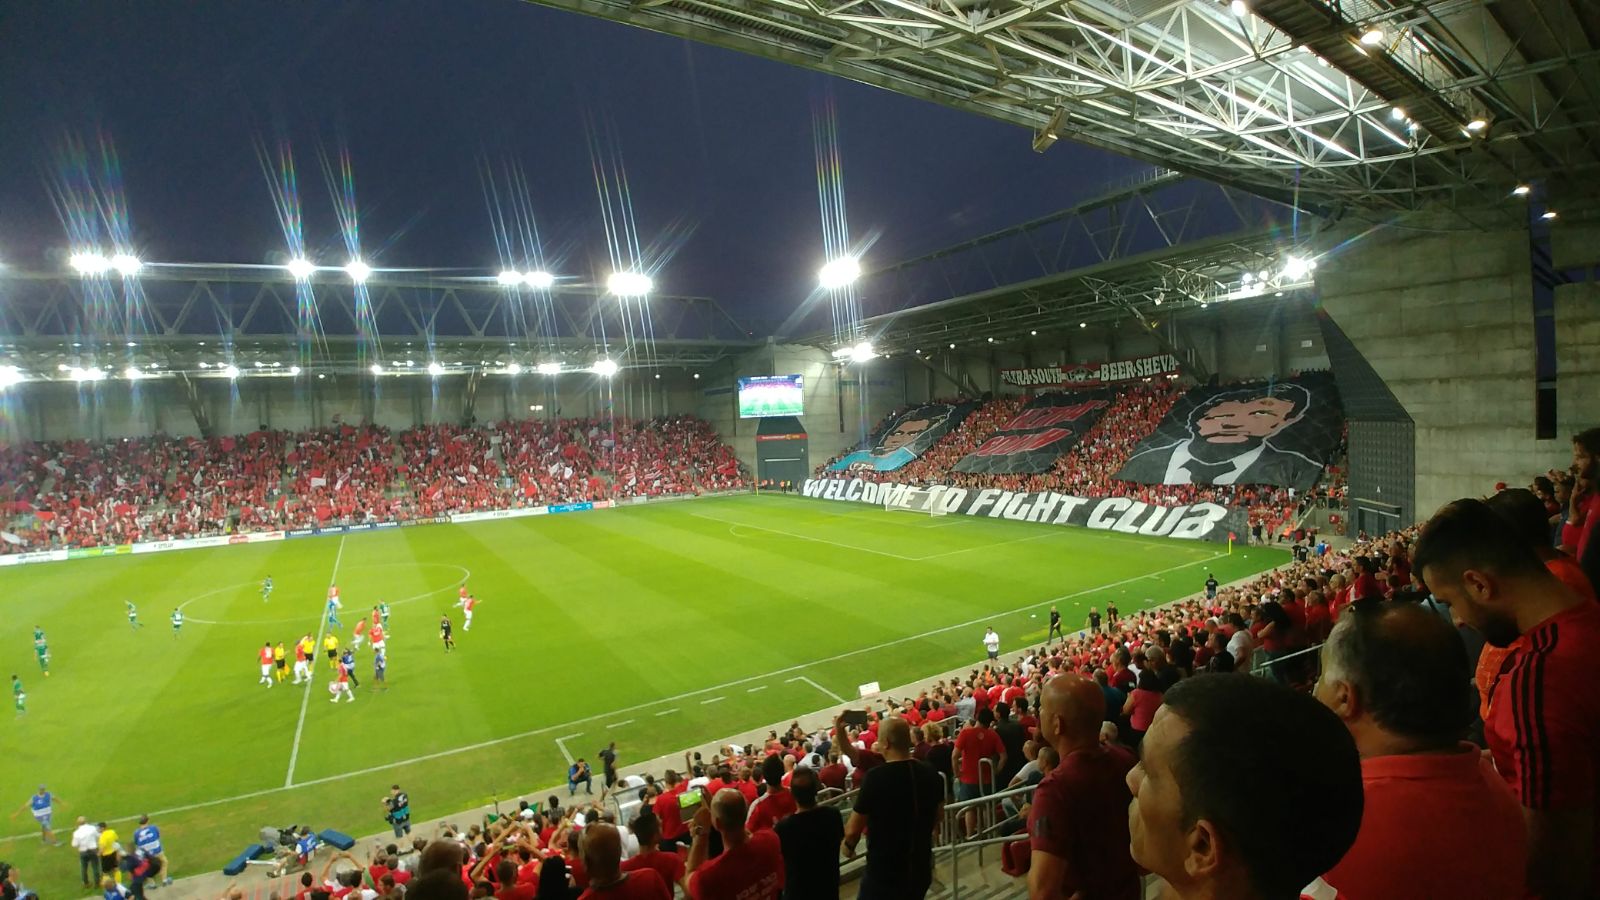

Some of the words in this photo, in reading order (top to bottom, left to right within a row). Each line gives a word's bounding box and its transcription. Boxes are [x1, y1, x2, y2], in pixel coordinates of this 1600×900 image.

[1100, 360, 1135, 382] BEER
[1135, 354, 1176, 377] SHEVA
[802, 478, 921, 509] WELCOME
[920, 484, 968, 513] TO
[965, 489, 1089, 525] FIGHT
[1086, 497, 1228, 539] CLUB
